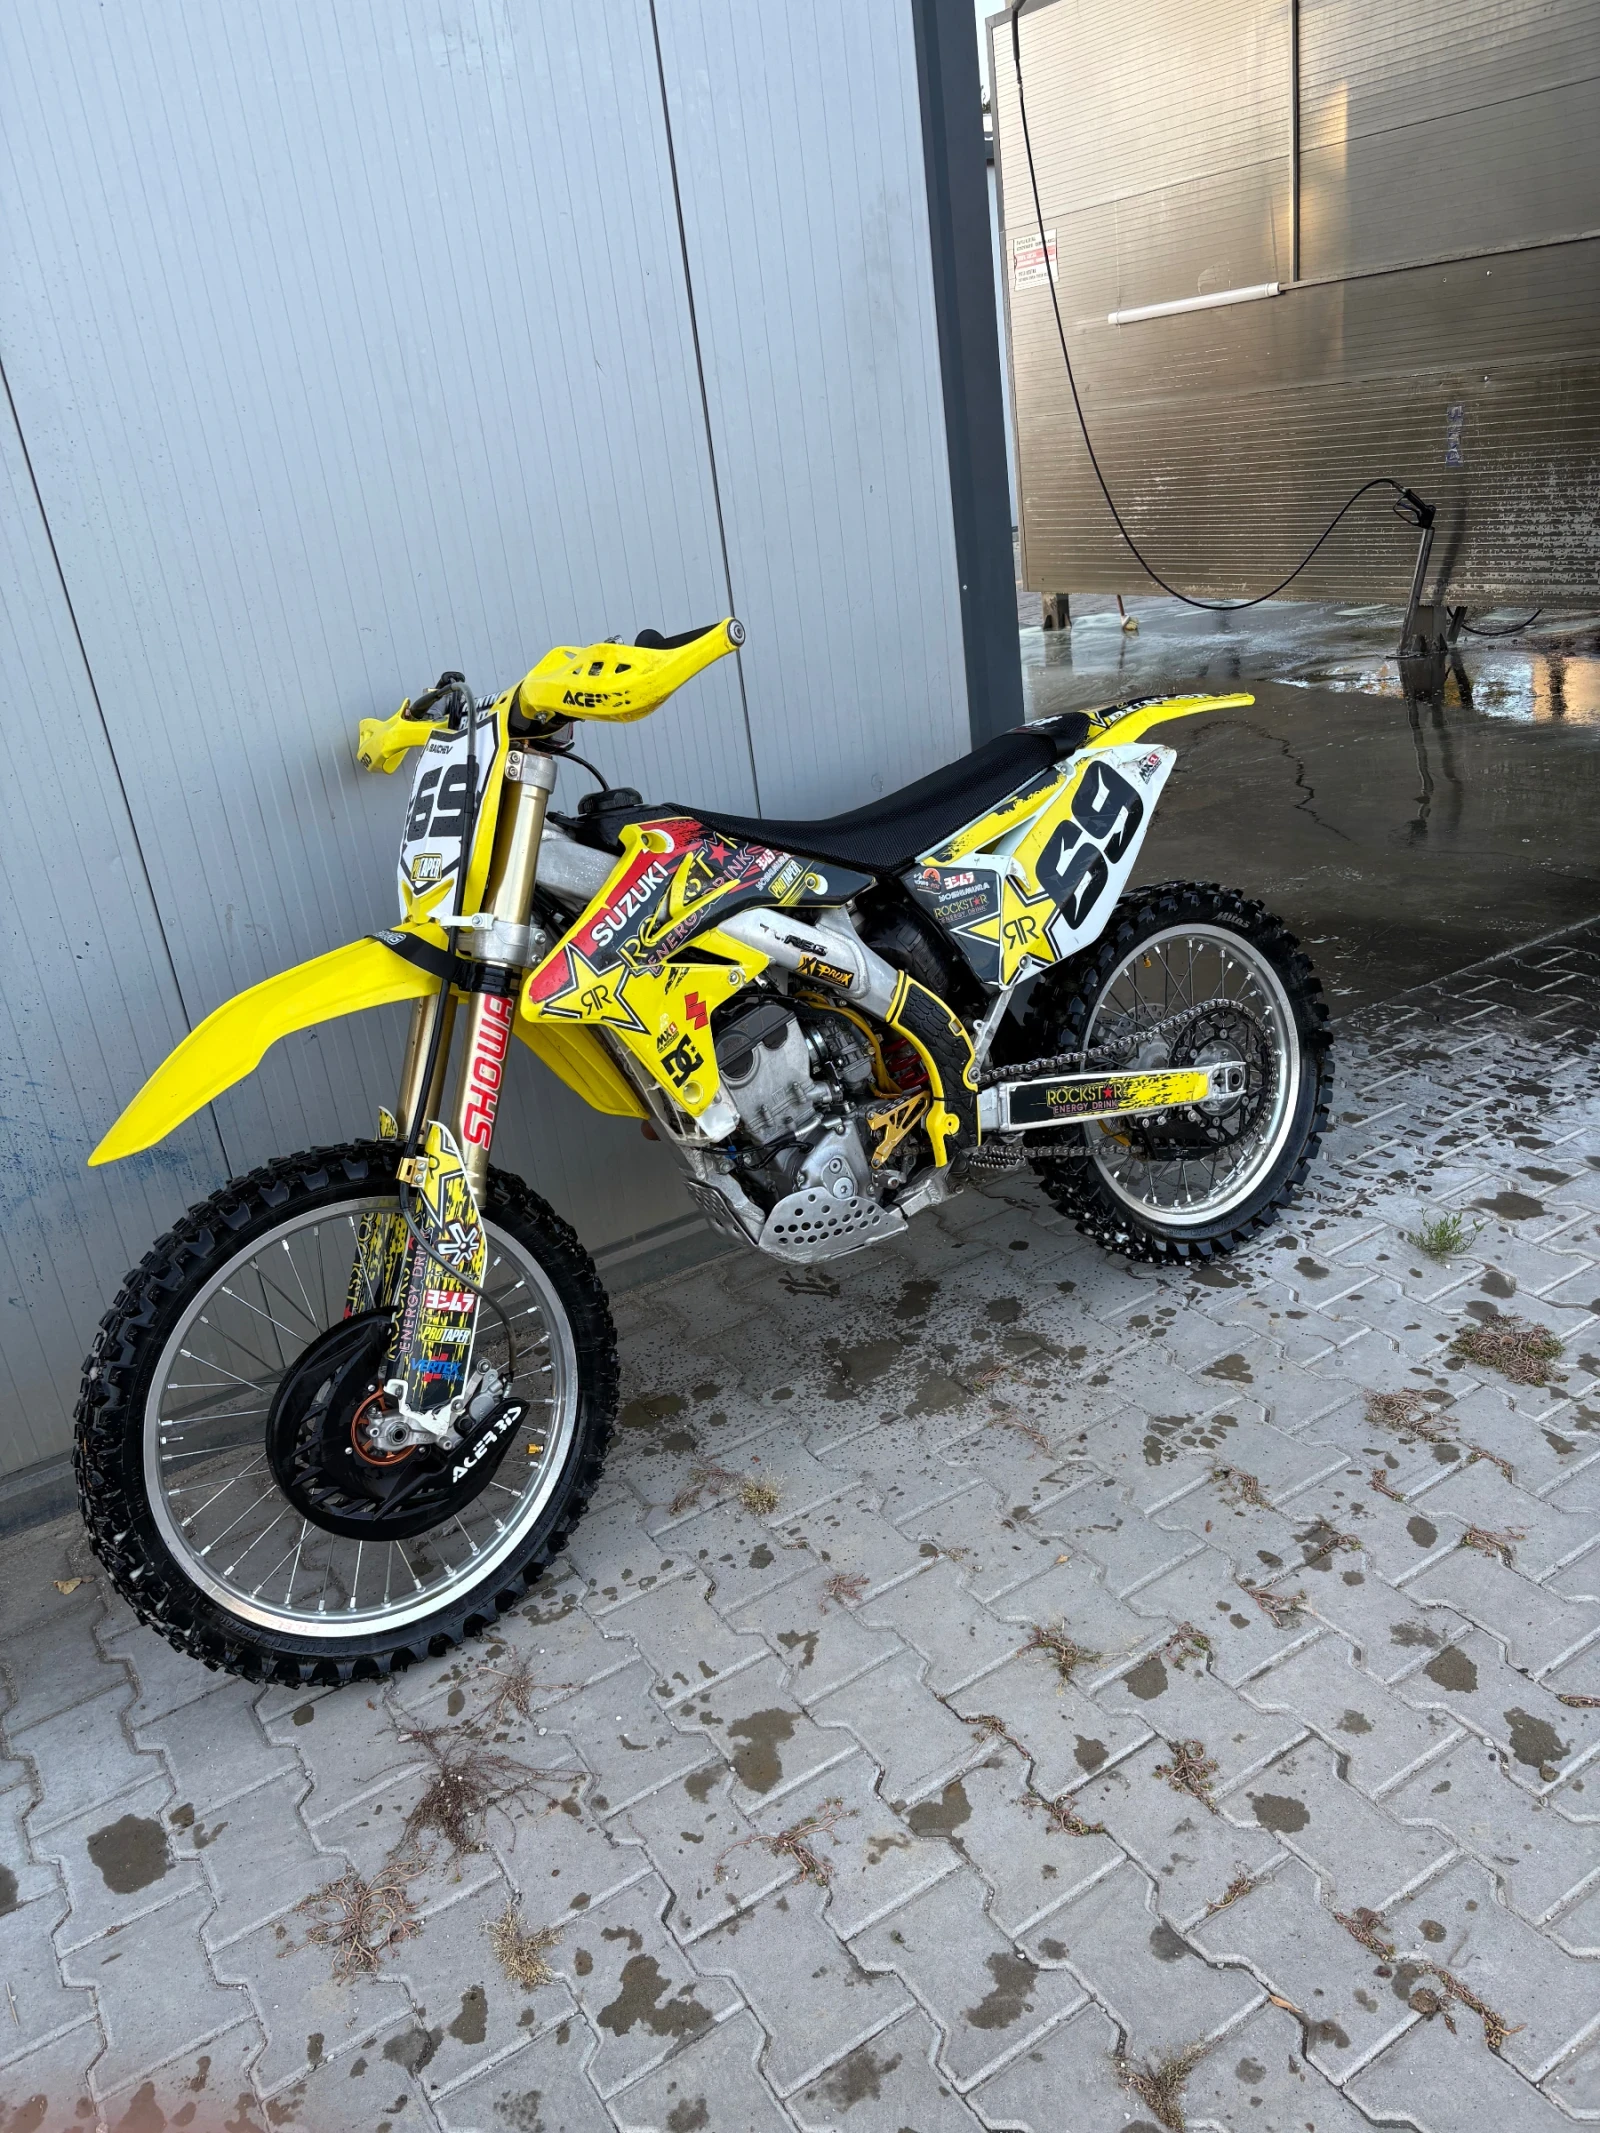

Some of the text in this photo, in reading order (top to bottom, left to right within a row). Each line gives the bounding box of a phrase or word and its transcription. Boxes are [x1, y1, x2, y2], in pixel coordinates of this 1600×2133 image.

[406, 763, 480, 843] 69
[1035, 760, 1144, 930] 69
[590, 860, 669, 948] SUZUKI
[770, 859, 802, 897] PROTAPER
[463, 992, 514, 1151] SHOWA
[1054, 1099, 1118, 1114] ENERGY DRINK
[399, 1284, 421, 1352] ENERGY
[426, 1289, 475, 1312] ヨシムラ
[422, 1327, 472, 1345] PROTAPER
[411, 1357, 462, 1375] VERTEX
